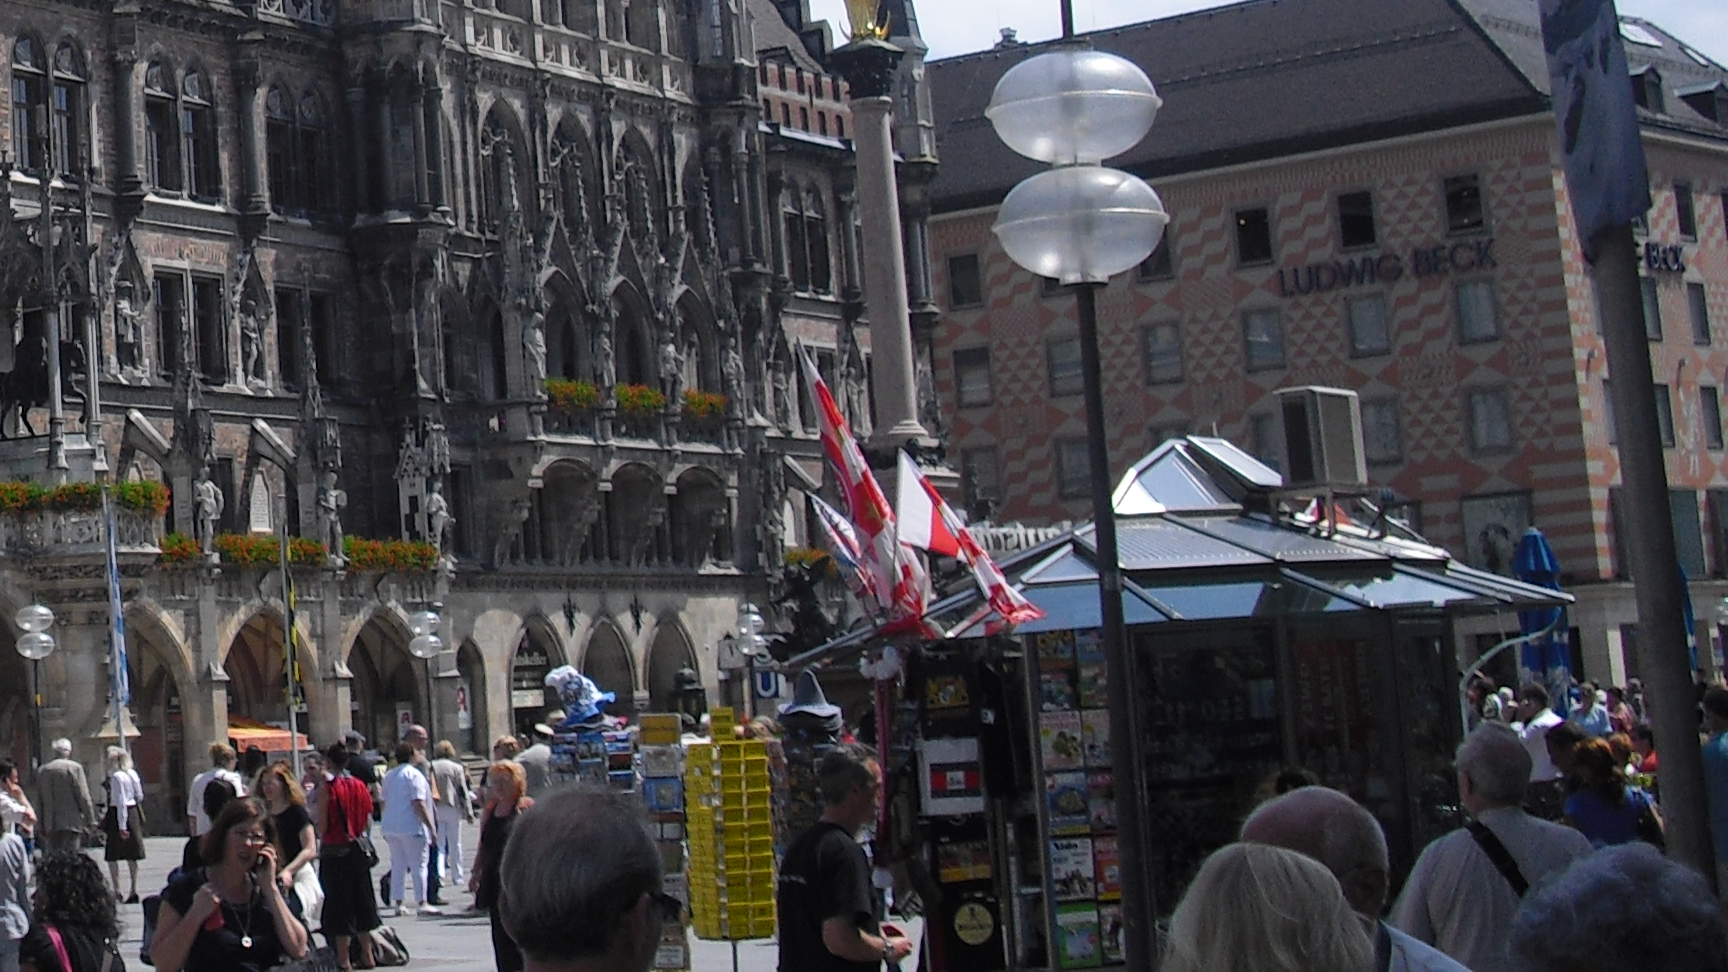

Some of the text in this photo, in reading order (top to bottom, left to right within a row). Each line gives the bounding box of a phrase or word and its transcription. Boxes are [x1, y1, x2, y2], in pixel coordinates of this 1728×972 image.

[1279, 237, 1498, 297] LUDWIG BECK
[756, 671, 777, 698] U
